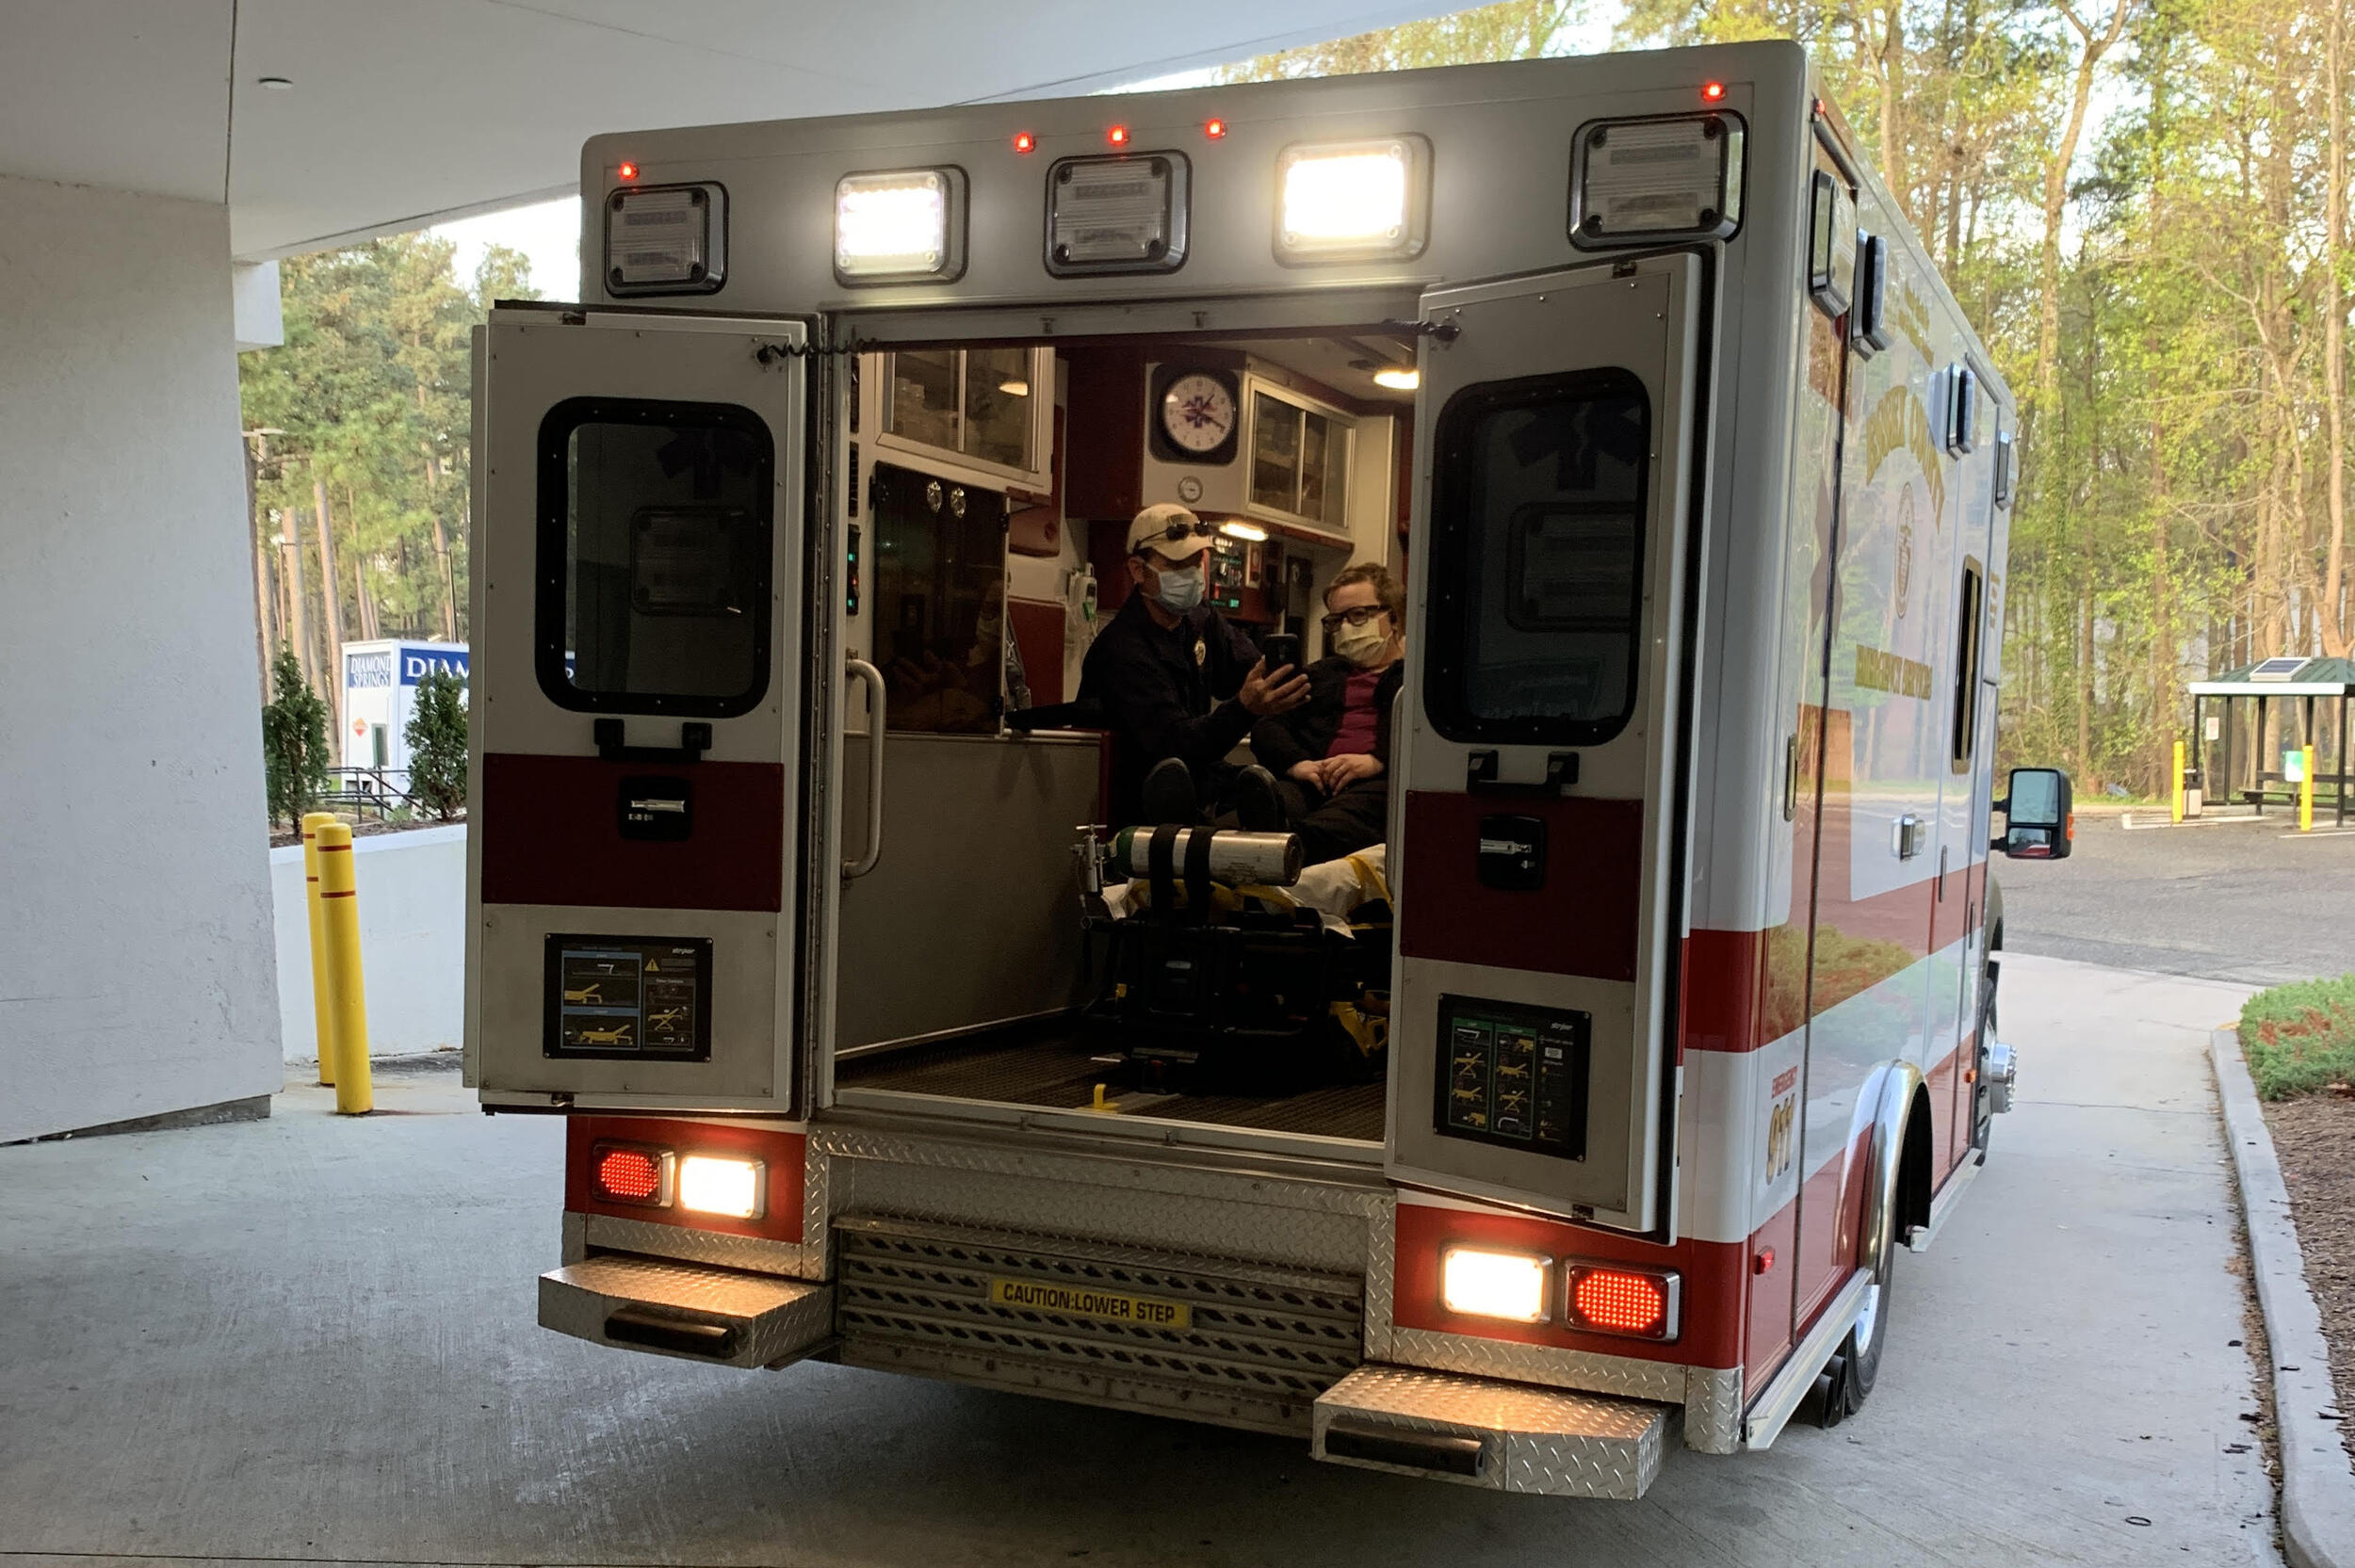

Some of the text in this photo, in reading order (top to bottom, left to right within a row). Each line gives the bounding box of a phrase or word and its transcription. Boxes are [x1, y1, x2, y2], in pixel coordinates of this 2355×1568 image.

[350, 655, 391, 673] DIAMOND
[353, 671, 389, 687] SPRINGS
[1136, 1301, 1175, 1323] STEP
